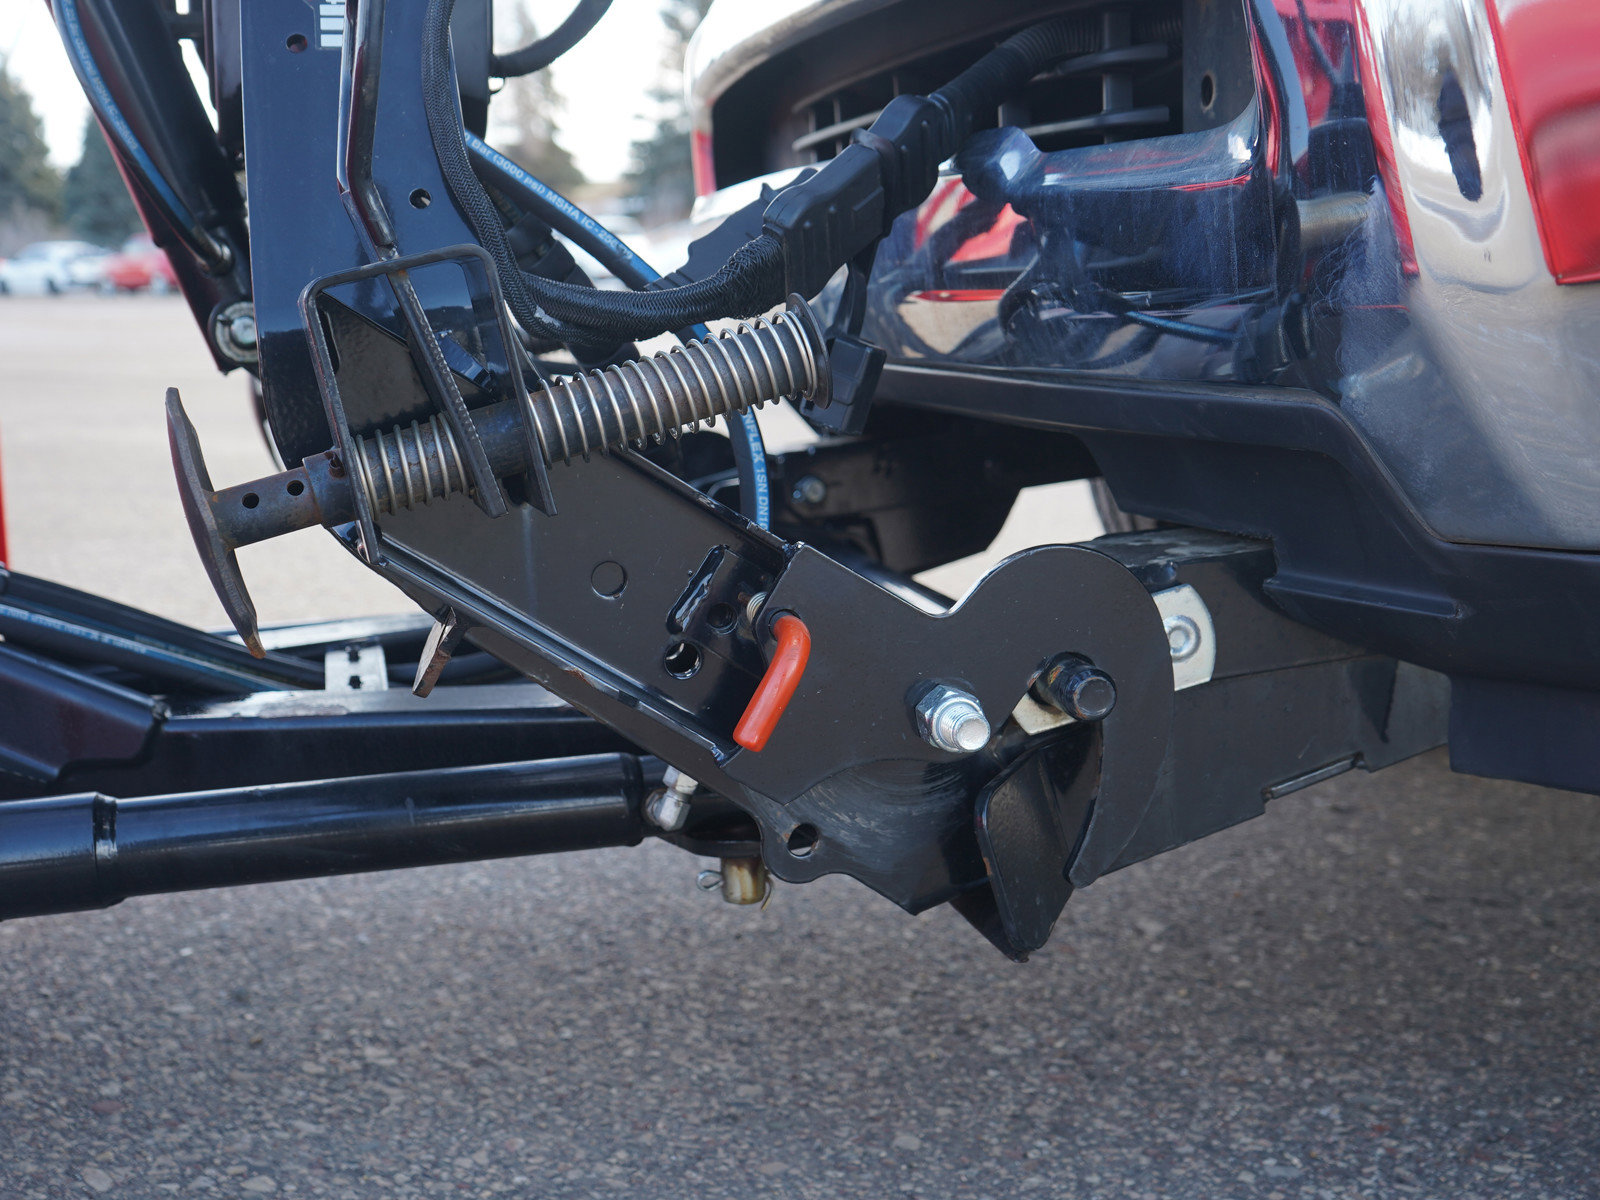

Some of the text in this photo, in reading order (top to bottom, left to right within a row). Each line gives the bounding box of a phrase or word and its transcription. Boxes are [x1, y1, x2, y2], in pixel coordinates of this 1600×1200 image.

[492, 153, 525, 179] (3000
[545, 190, 581, 220] MSHA
[743, 413, 764, 462] NFLEX
[755, 468, 767, 493] 1SN
